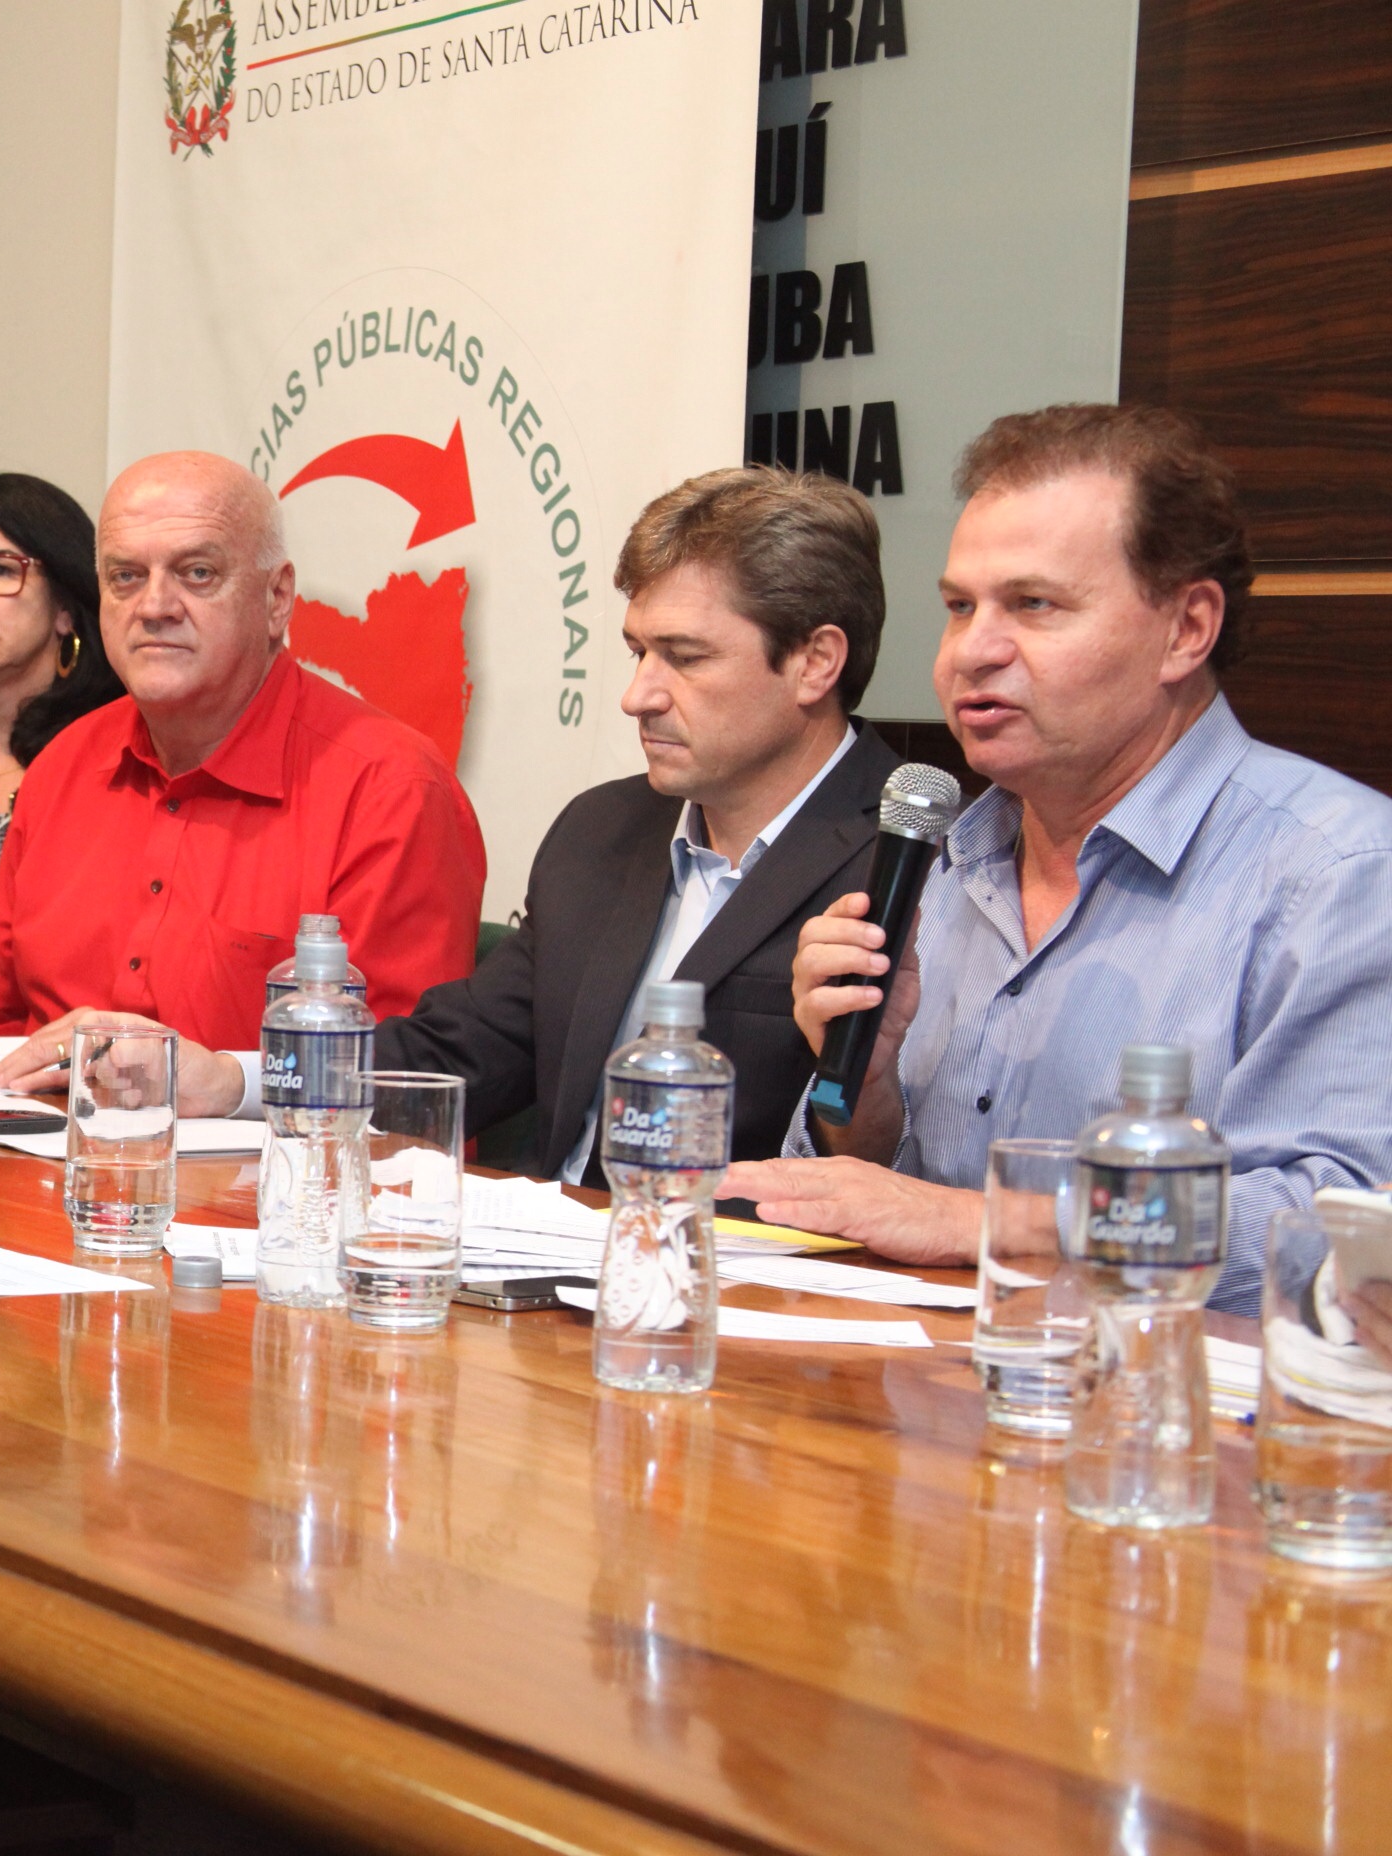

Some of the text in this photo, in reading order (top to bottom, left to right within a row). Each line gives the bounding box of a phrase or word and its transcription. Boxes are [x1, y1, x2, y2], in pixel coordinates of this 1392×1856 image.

[760, 0, 907, 82] ARA
[246, 0, 700, 123] DO ESTADO DE SANTA CATARINA
[313, 307, 484, 387] PÚBLICAS
[488, 366, 589, 728] REGIONAIS
[265, 1054, 284, 1071] Da
[261, 1069, 304, 1089] uarda
[622, 1107, 650, 1128] Da
[608, 1122, 673, 1148] Guarda
[1109, 1197, 1146, 1222] Da
